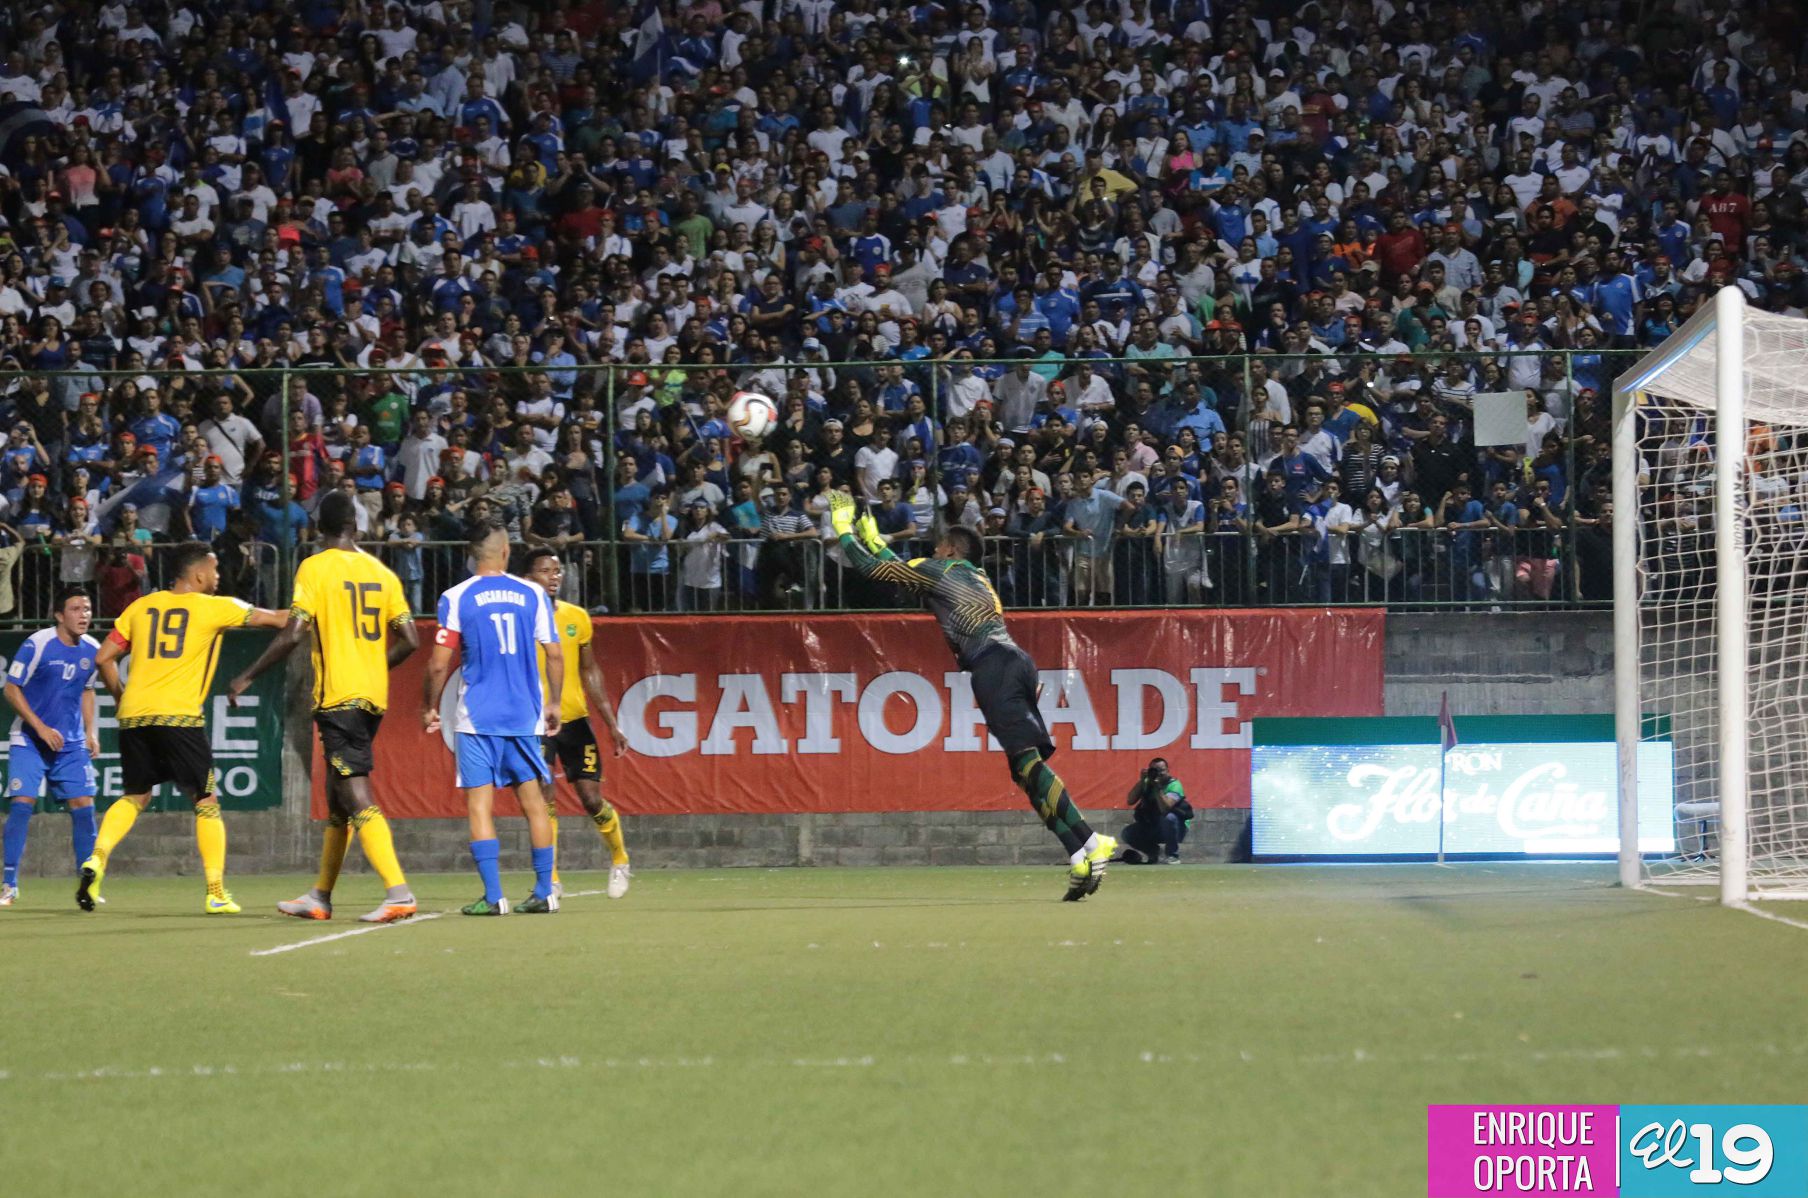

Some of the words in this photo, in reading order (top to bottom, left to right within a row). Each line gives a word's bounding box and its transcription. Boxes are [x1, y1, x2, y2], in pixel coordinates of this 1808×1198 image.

[474, 589, 525, 607] NICARAGUA
[344, 580, 382, 641] 15
[146, 607, 189, 659] 19
[435, 628, 448, 644] C
[489, 612, 518, 655] 11
[62, 663, 76, 681] 10
[584, 743, 597, 766] 5
[1445, 752, 1503, 776] RON
[1497, 762, 1608, 838] Caña
